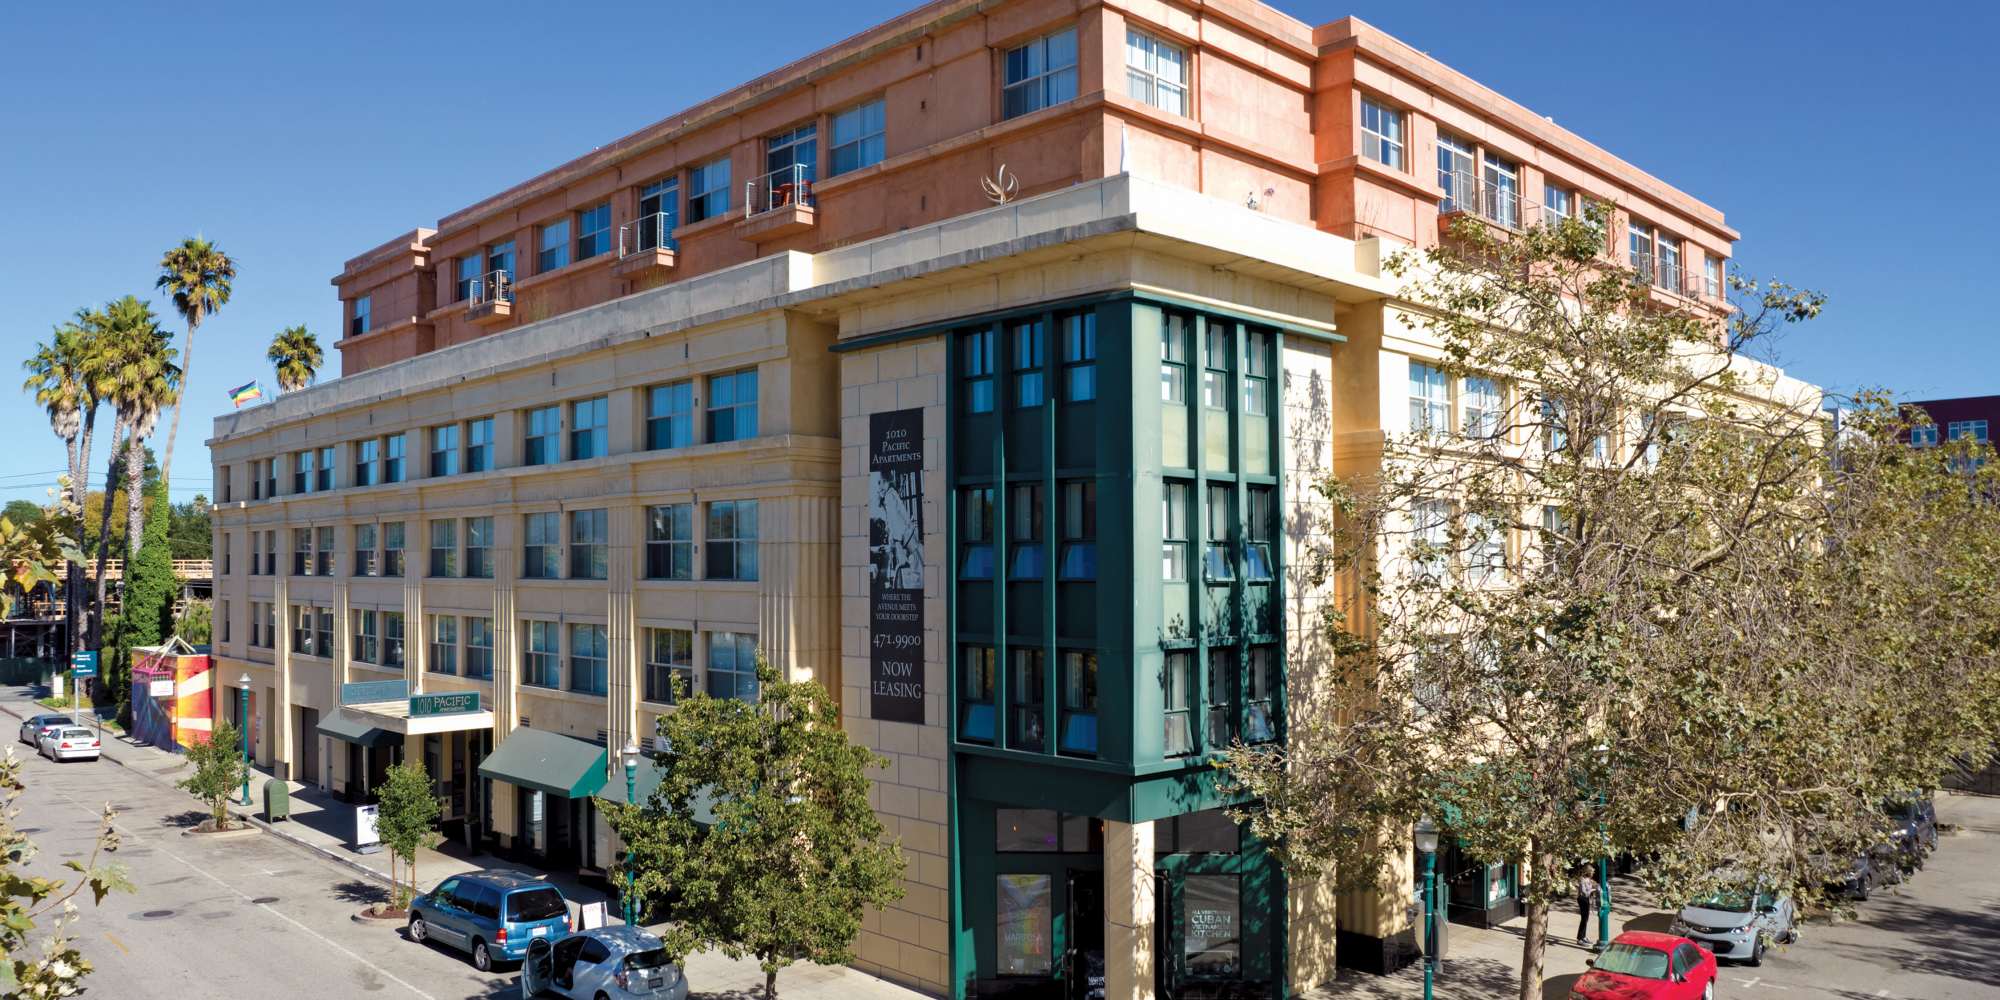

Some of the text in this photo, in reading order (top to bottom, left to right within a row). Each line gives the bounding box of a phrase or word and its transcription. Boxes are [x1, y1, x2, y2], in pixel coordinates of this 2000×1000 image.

[886, 429, 907, 439] 1010
[882, 441, 910, 452] PACIFIC
[872, 452, 921, 464] APARTMENTS
[873, 634, 921, 648] 471.9900
[882, 661, 912, 677] NOW
[873, 681, 921, 699] LEASING
[434, 695, 471, 708] PACIFIC
[1191, 915, 1231, 924] CUBAN
[1191, 929, 1231, 937] KITCHEN
